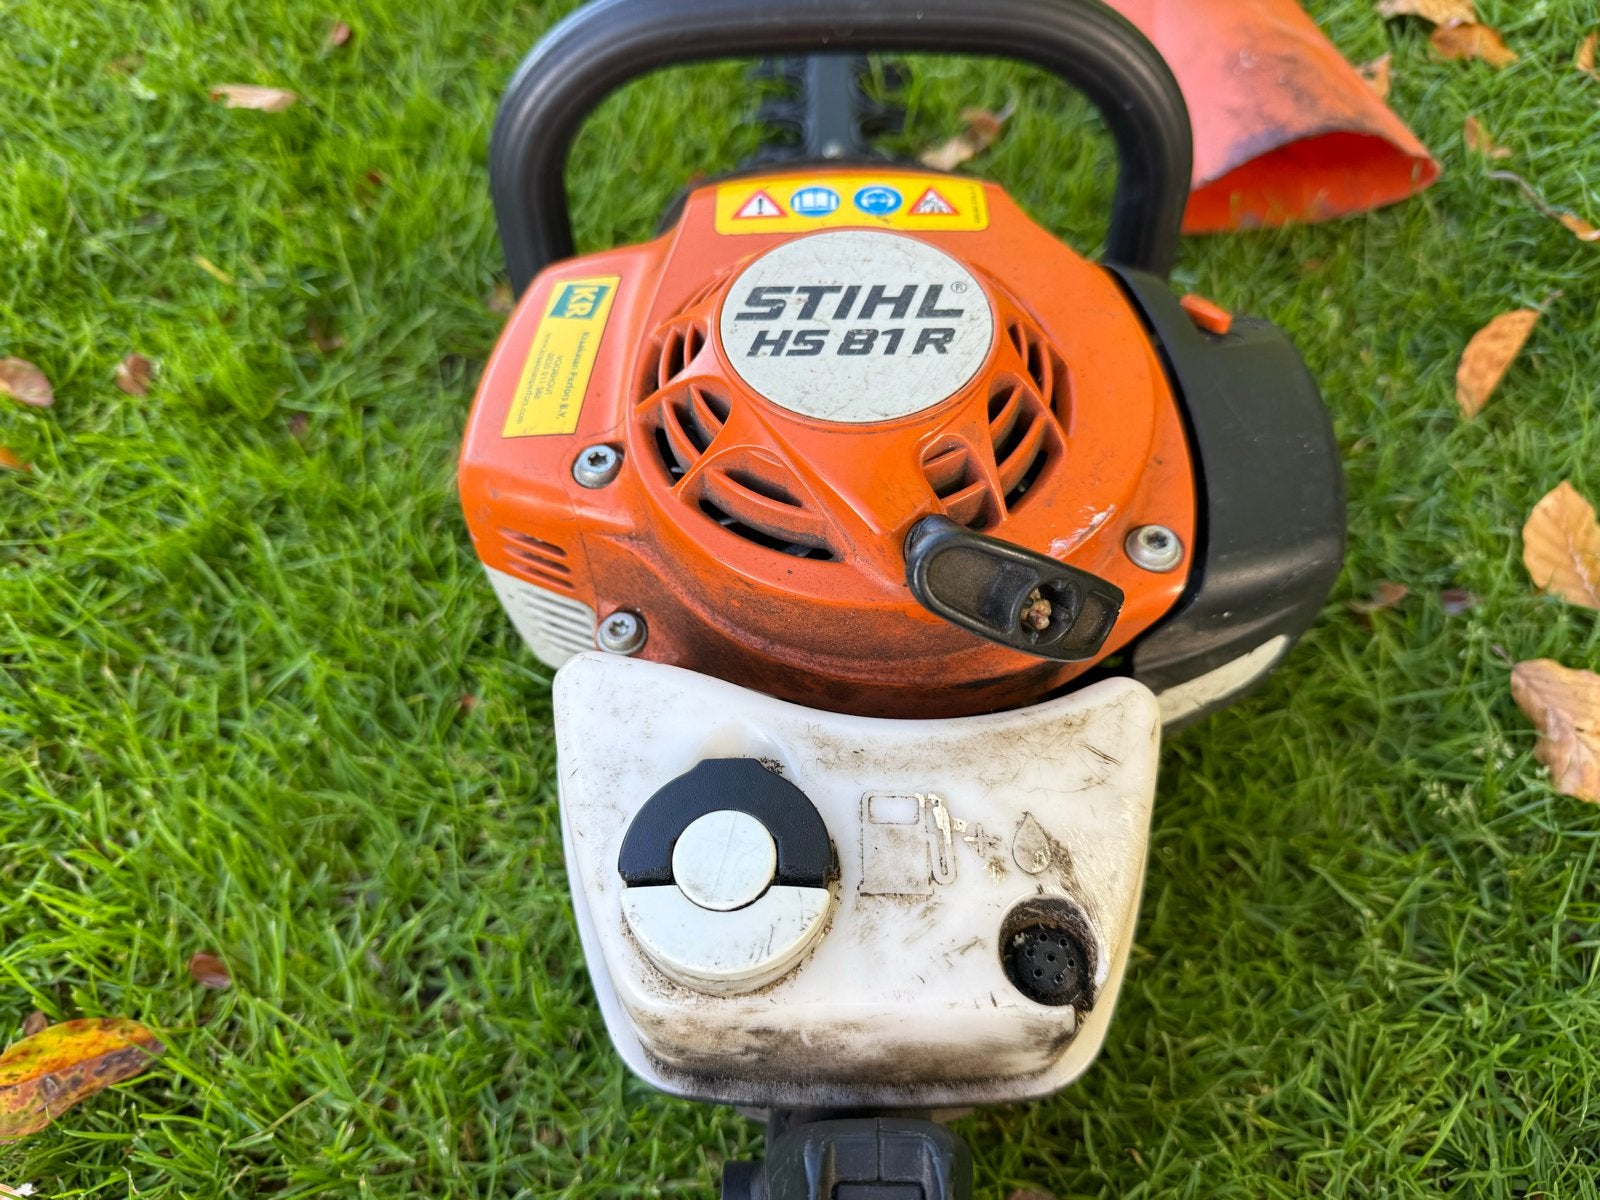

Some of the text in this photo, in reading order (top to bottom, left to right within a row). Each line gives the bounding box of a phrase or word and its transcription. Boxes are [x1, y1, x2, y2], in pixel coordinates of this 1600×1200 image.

[566, 287, 599, 318] KR
[734, 284, 964, 320] STIHL
[746, 327, 956, 357] HS 81 R
